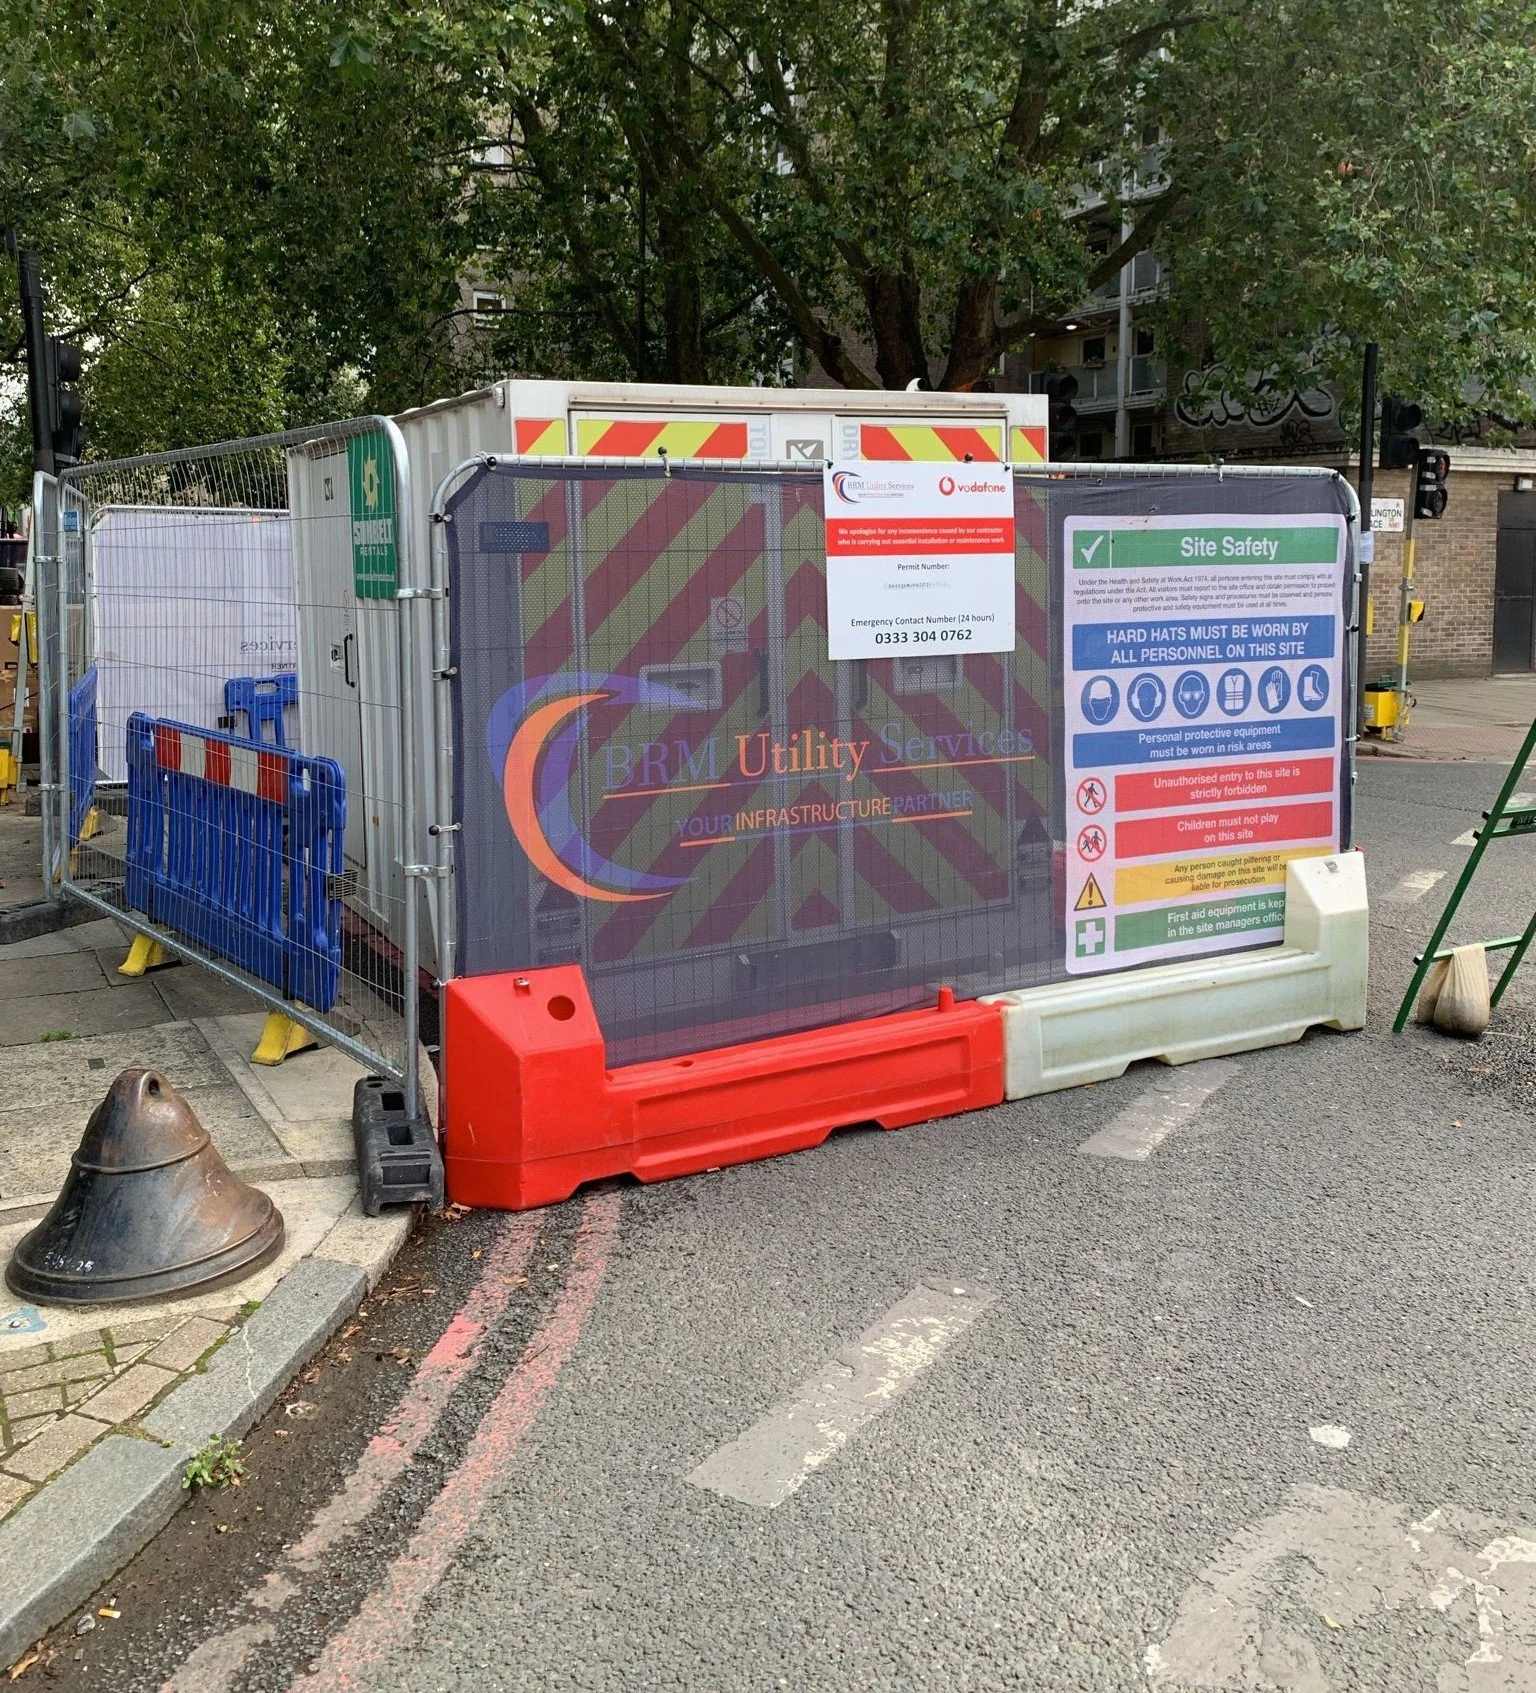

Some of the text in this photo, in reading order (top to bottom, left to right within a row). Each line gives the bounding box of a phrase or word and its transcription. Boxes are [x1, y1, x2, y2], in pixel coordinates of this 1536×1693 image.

[958, 481, 1006, 493] vodafone
[353, 518, 392, 545] SUNBELT
[849, 528, 877, 536] apologise
[897, 527, 938, 535] inconvenience
[958, 527, 966, 535] by
[857, 538, 880, 546] carrying
[892, 537, 917, 545] essential
[1180, 535, 1279, 561] Site Safety
[360, 546, 388, 556] RENTALS
[1142, 577, 1158, 585] Safety
[1218, 575, 1240, 583] persons
[1074, 588, 1106, 596] regulations
[1181, 594, 1198, 602] Safety
[1133, 605, 1161, 613] protective
[1192, 603, 1222, 611] equipment
[851, 613, 995, 627] Emergency Contact Number (24 hours)
[875, 629, 972, 644] 0333 304 0762
[1107, 622, 1309, 644] HARD HATS MUST BE WORN BY
[1111, 641, 1305, 664] ALL PERSONNEL ON THIS SITE
[1138, 724, 1281, 744] Personal protective equipment
[601, 722, 1034, 791] BRM Utility Services
[1150, 741, 1272, 759] must be worn in risk areas
[1153, 767, 1301, 789] Unauthorised entry to this site is
[1190, 784, 1267, 801] strictly forbidden
[677, 789, 973, 837] YOUR INFRASTRUCTURE PARTNER
[1177, 813, 1279, 833] Children must not play
[1204, 829, 1254, 843] on this site
[1174, 854, 1281, 875] Any person caught pilfering or
[1165, 863, 1287, 886] causing damage on this site will be
[1191, 876, 1266, 892] liable for prosecution
[1167, 911, 1189, 924] First
[1191, 908, 1206, 921] aid
[1207, 902, 1256, 918] equipment
[1258, 900, 1267, 911] is
[1167, 911, 1285, 938] in the site managers offic
